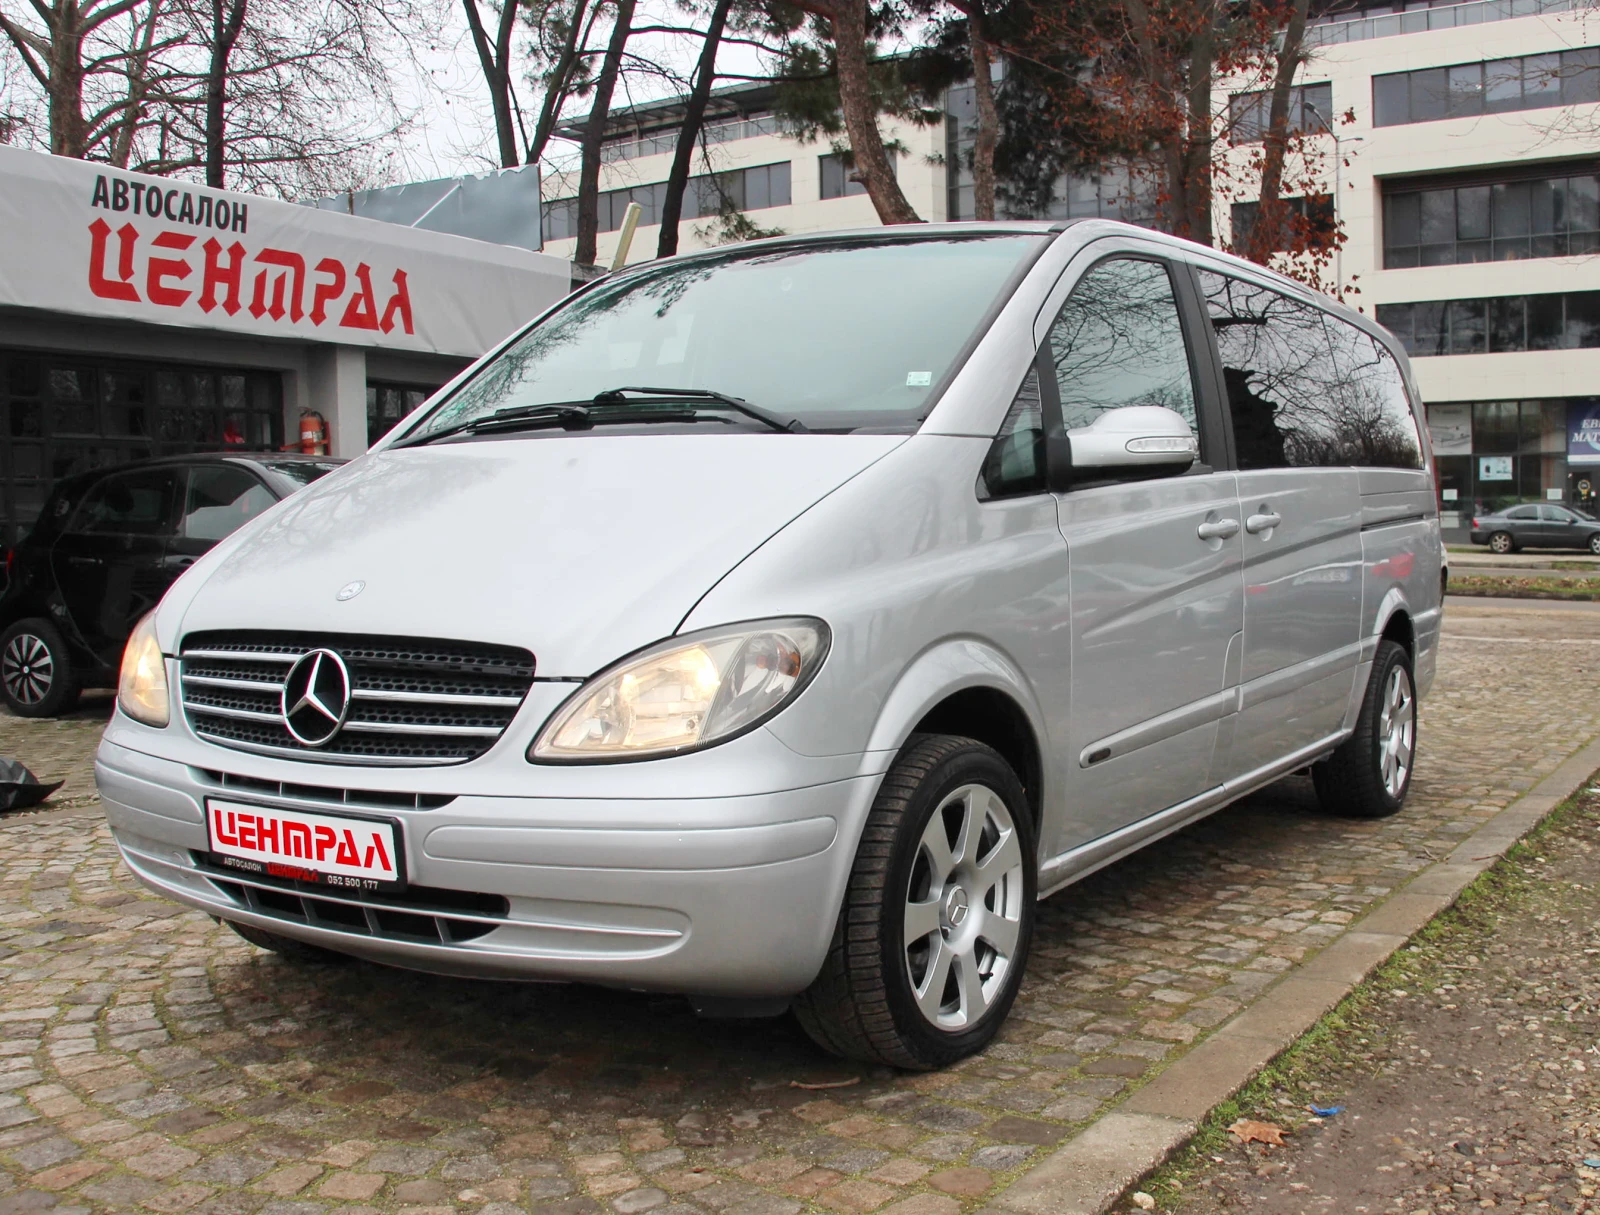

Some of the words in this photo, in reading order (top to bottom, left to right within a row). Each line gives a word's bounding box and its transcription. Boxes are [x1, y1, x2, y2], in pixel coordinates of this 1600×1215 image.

[91, 174, 248, 234] АВТОСАЛОН
[88, 217, 414, 335] ЦЕНТРАЛ
[214, 809, 392, 871] ЦЕНТРАЛ
[223, 857, 262, 872] АВТОСАЛОН
[327, 875, 344, 885] 052
[345, 877, 361, 888] 500
[363, 879, 379, 890] 177
